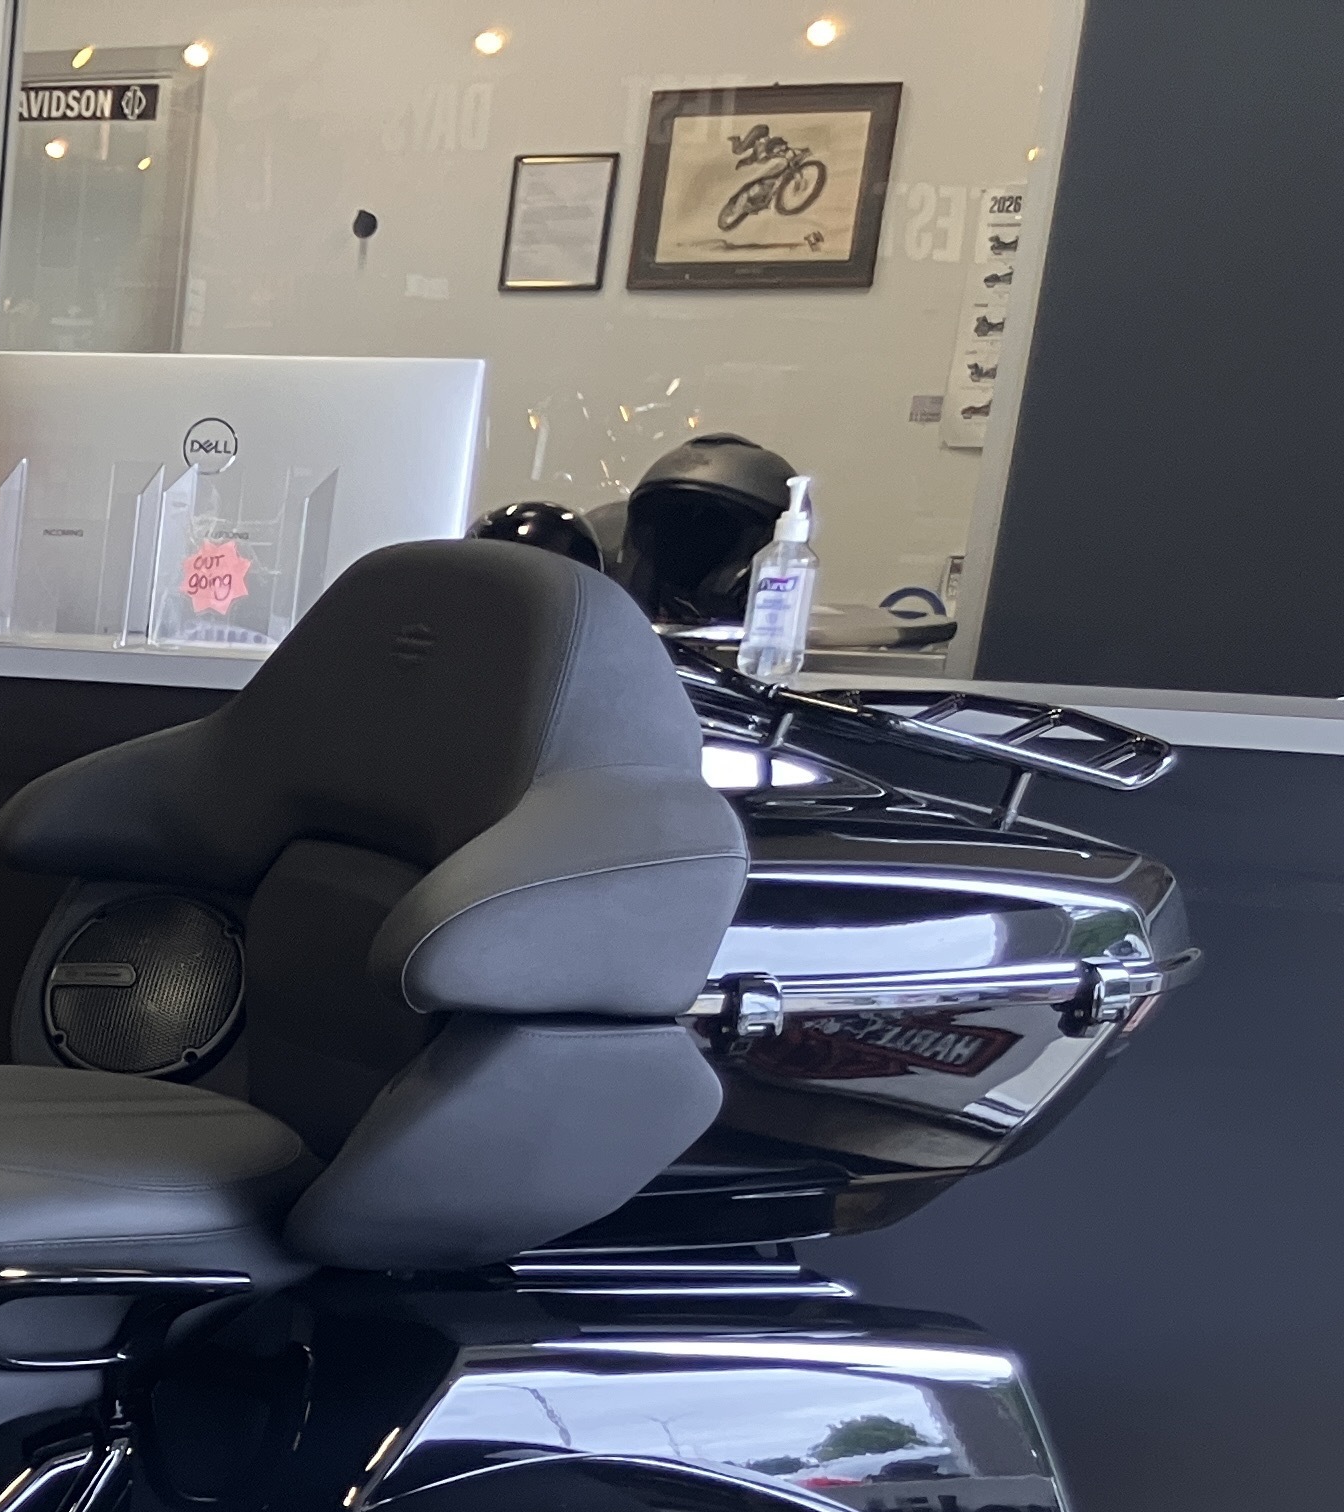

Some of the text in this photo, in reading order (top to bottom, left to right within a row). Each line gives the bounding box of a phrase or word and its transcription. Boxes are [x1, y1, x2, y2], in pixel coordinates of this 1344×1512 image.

[989, 195, 1022, 213] 2026
[190, 440, 232, 454] DELL
[193, 554, 225, 570] OUT
[187, 573, 232, 601] going
